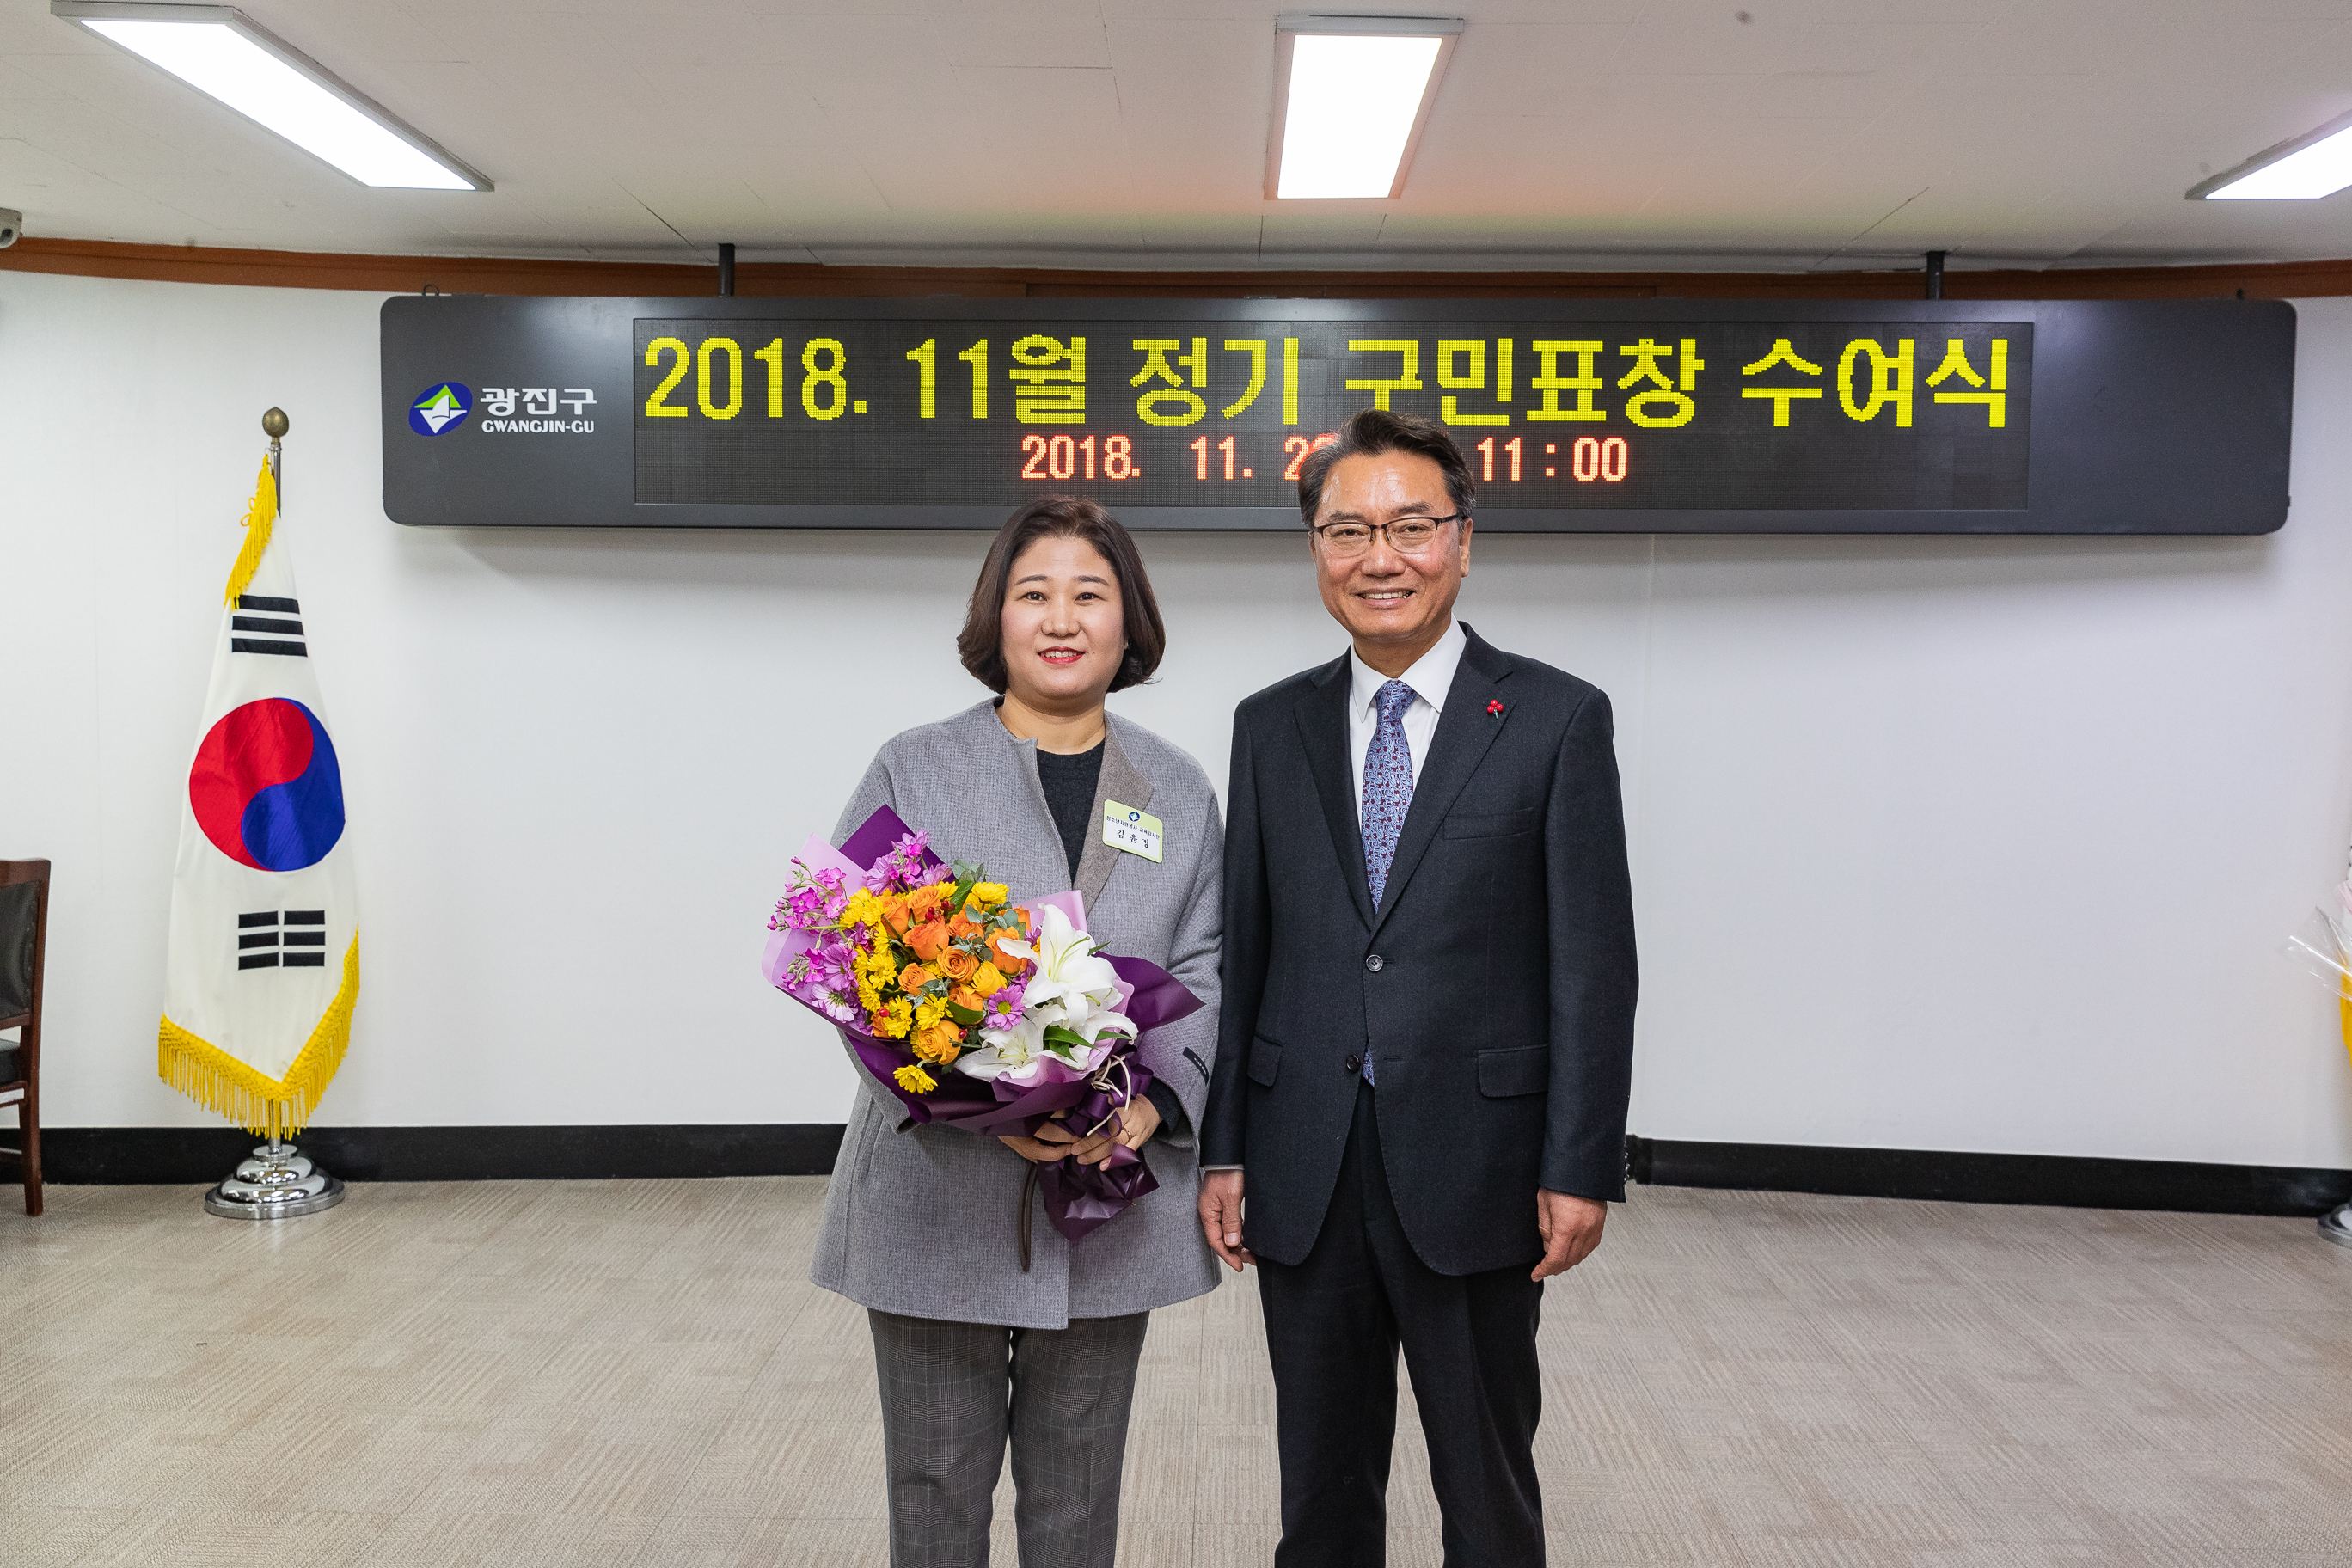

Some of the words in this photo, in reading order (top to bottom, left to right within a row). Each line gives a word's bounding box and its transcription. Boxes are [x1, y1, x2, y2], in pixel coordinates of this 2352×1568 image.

[644, 336, 867, 420] 2018.
[906, 334, 1087, 426] 11월
[1130, 336, 1299, 426] 정기
[1345, 337, 1705, 428] 구민표창
[1741, 338, 2009, 429] 수여식
[480, 388, 597, 416] 광진구
[481, 420, 595, 433] GWANGJIN-GU
[1020, 434, 1142, 481] 2018.
[1190, 435, 1253, 481] 11.
[1283, 432, 1338, 481] 2
